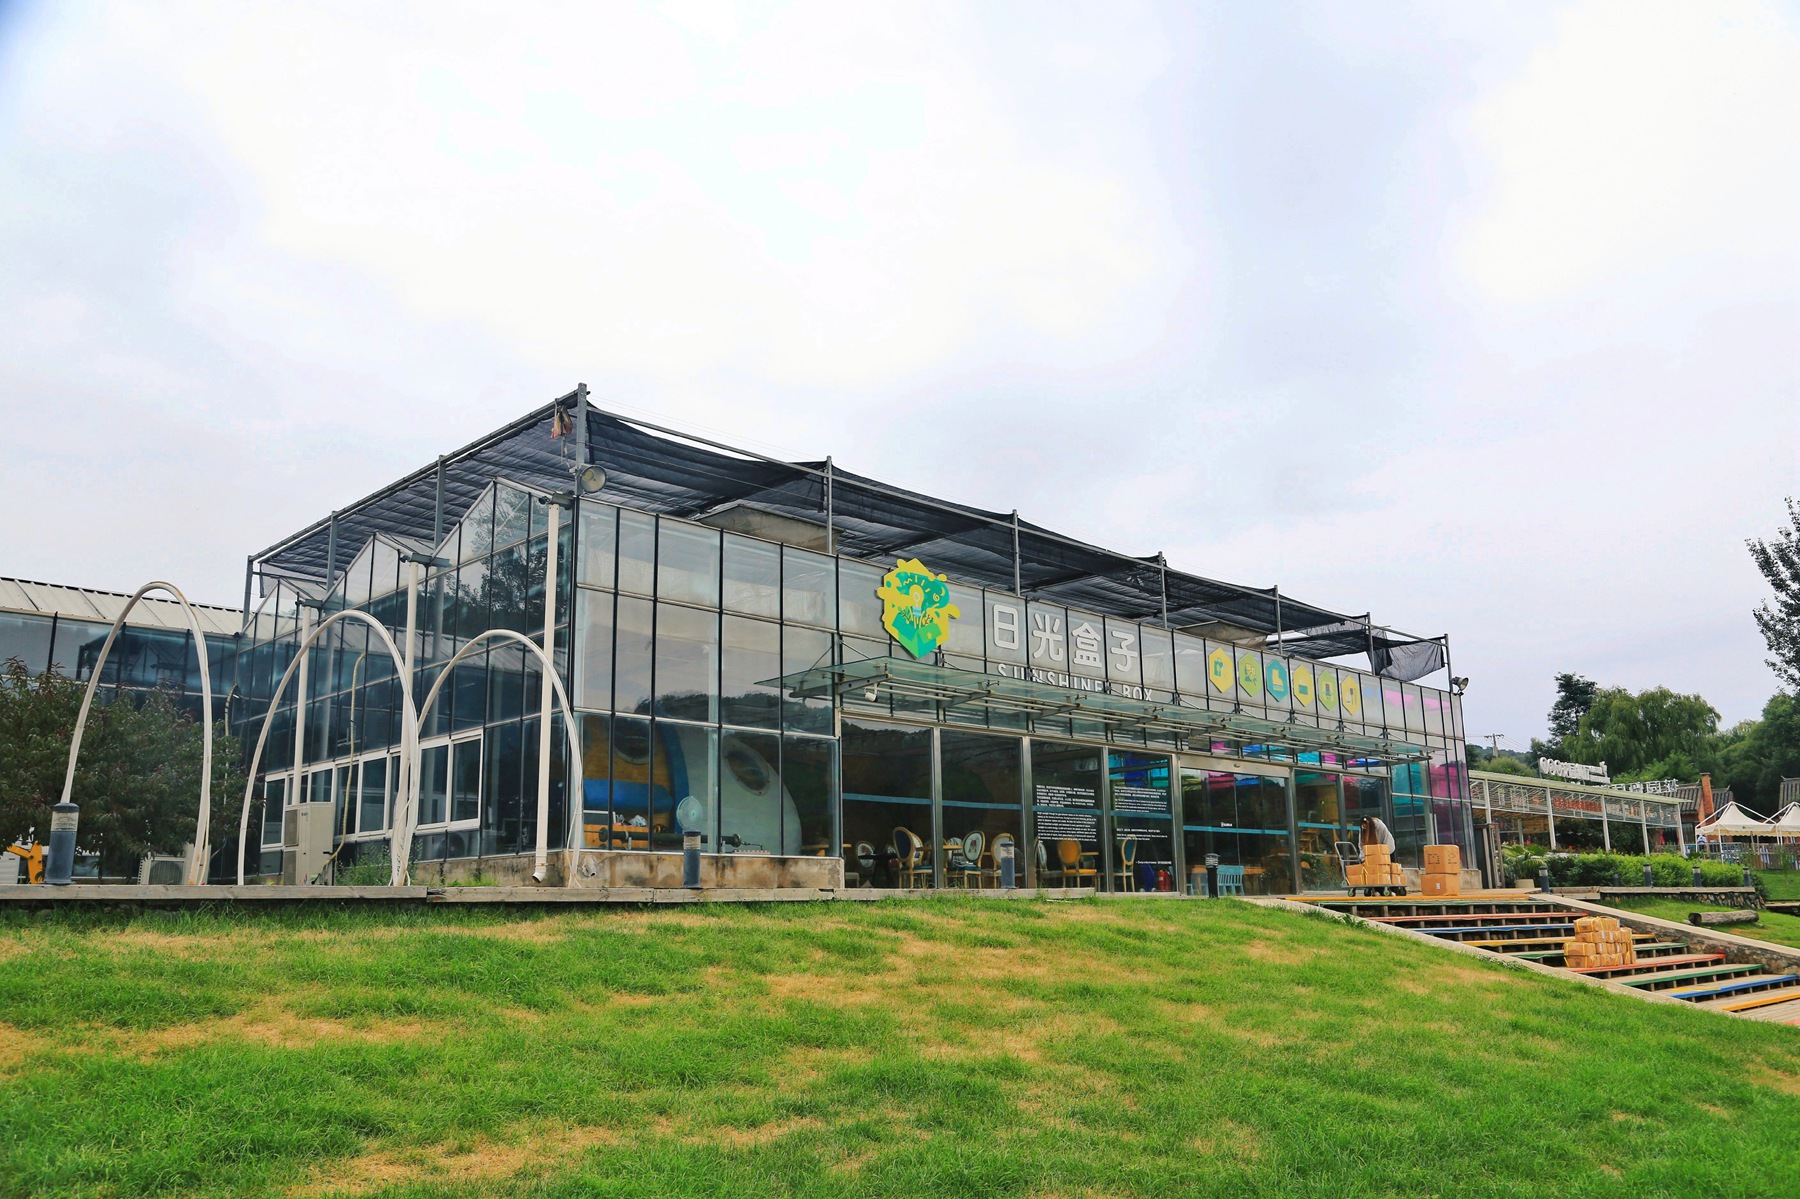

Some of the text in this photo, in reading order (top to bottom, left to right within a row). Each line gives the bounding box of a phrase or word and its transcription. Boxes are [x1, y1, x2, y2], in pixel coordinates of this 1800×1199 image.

[993, 604, 1137, 672] 日光盒子
[997, 663, 1153, 700] SUNSHINE BOX
